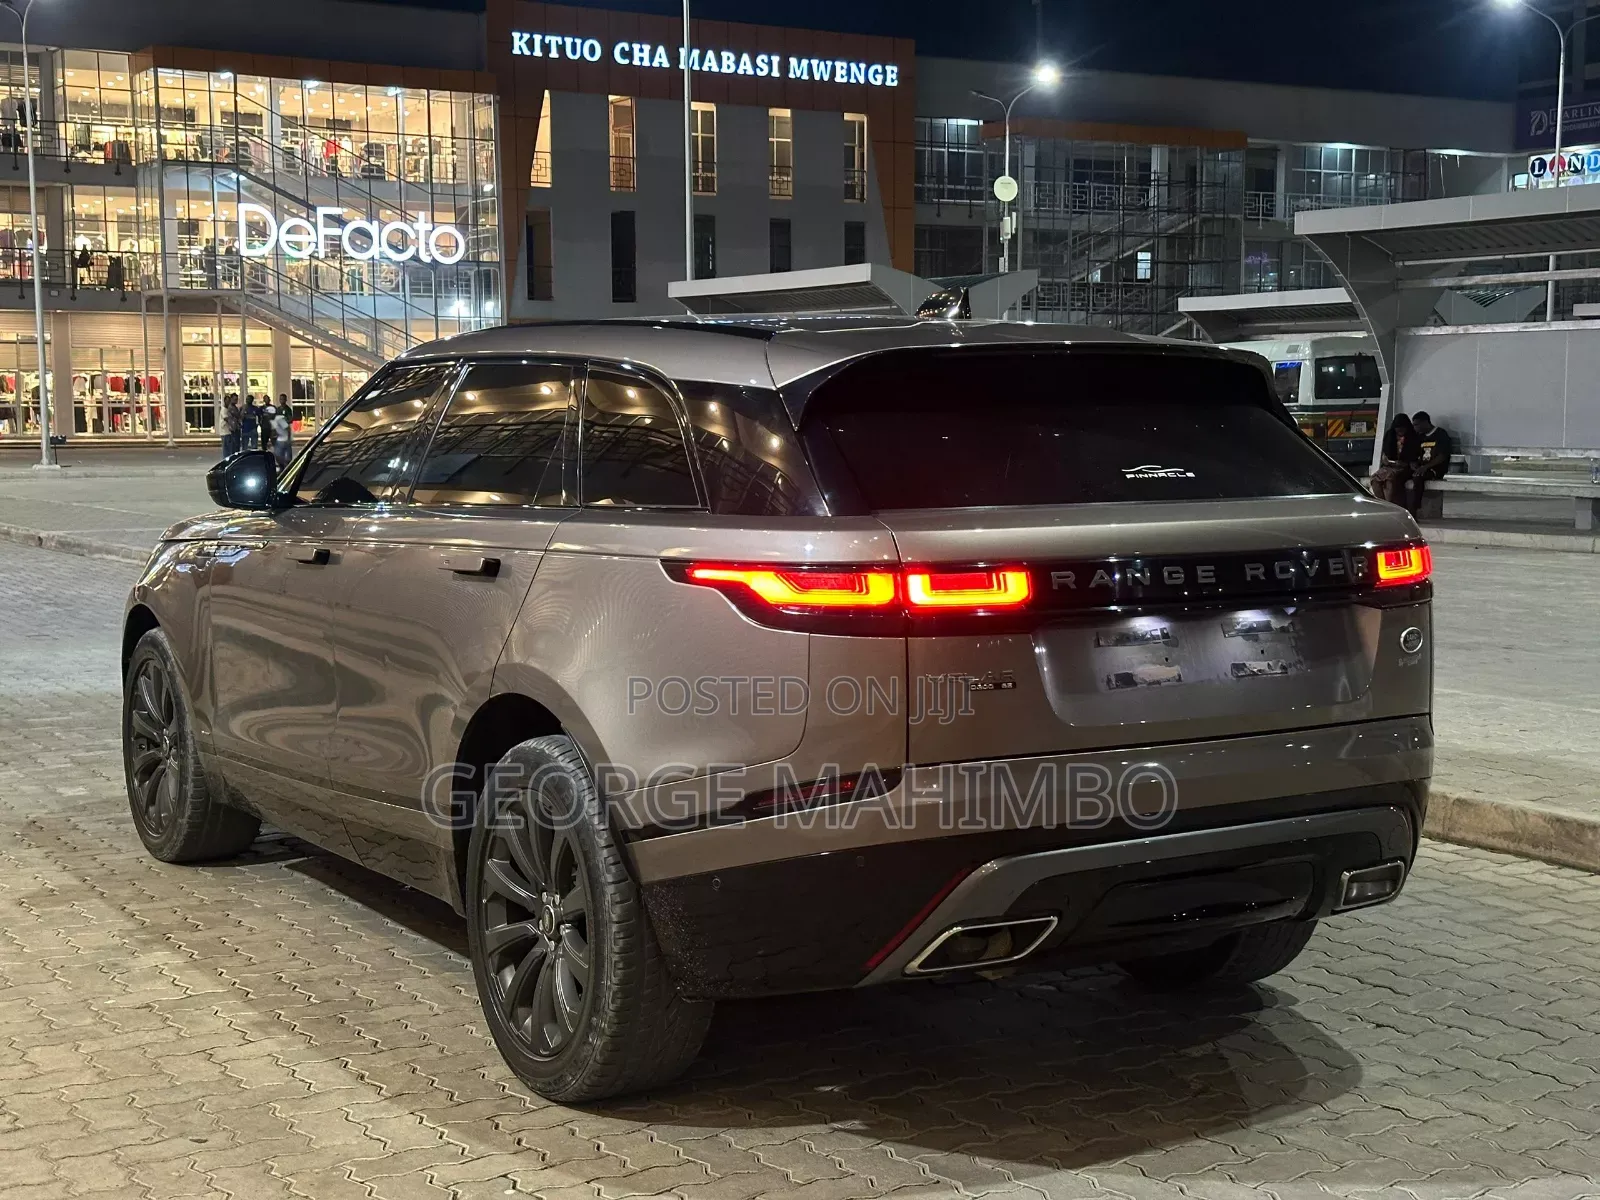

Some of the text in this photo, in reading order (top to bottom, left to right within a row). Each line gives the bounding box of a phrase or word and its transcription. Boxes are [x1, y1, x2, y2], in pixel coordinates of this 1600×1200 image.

[511, 31, 899, 87] KITUO CHA MABASI MWENGE
[237, 202, 466, 265] DeFacto
[1050, 555, 1370, 590] RANGE ROVER
